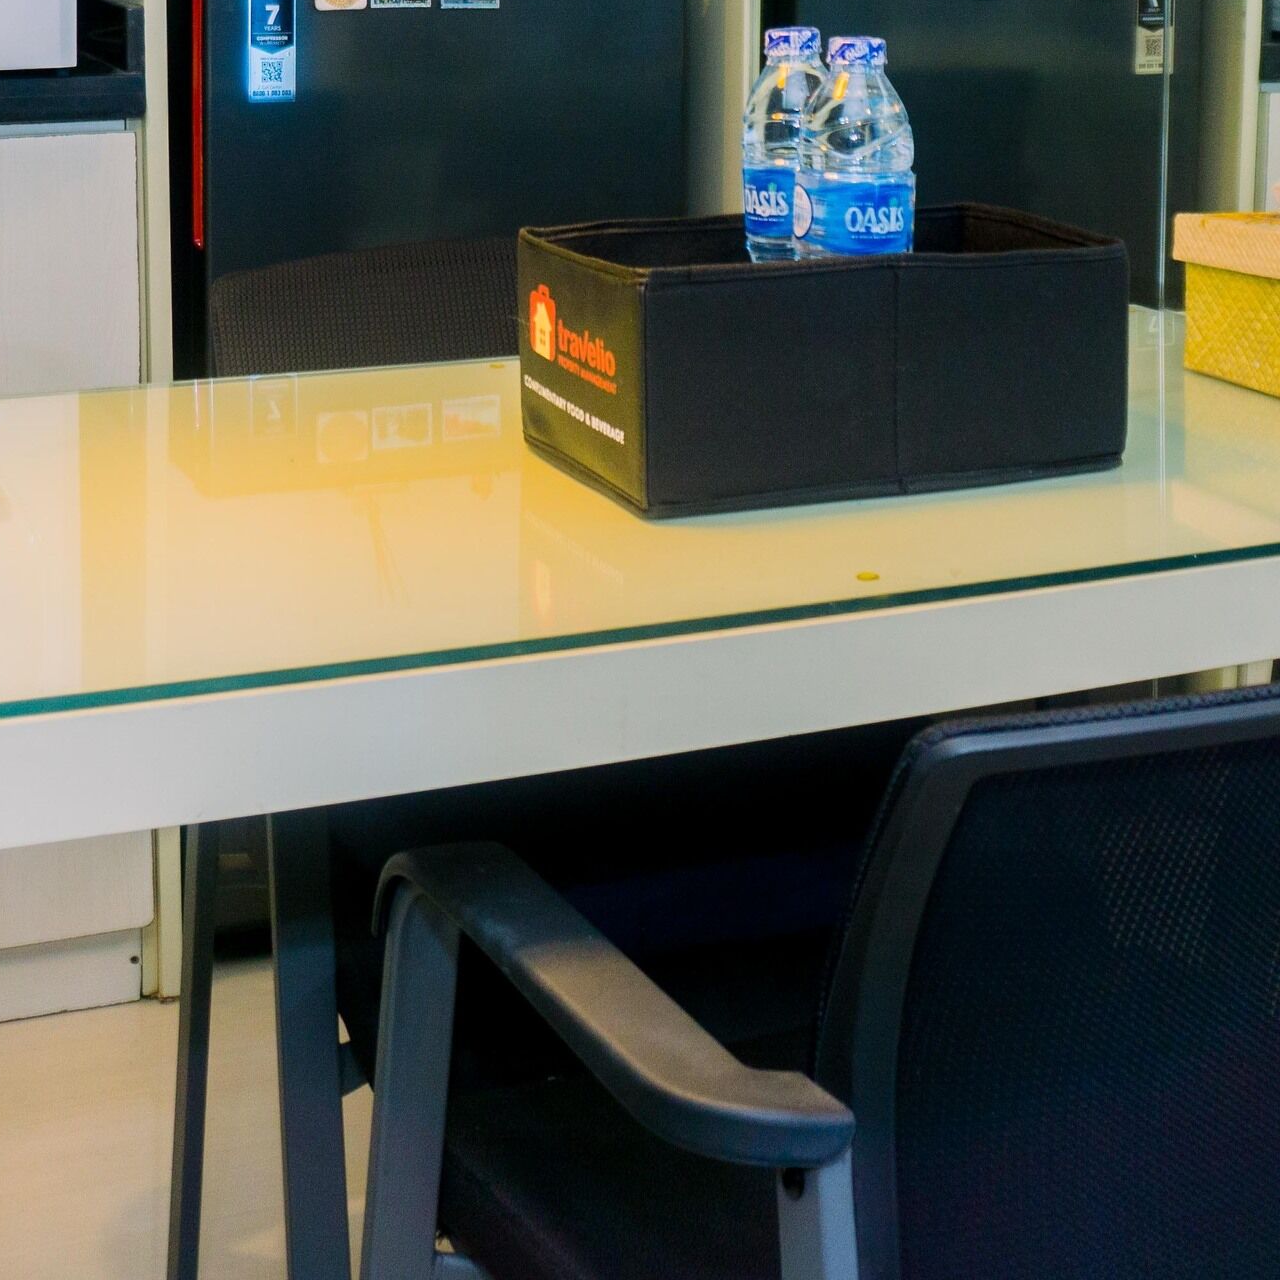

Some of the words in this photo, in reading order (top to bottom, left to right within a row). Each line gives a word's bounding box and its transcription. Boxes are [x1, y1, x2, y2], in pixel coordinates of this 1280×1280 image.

[265, 4, 280, 25] 7
[745, 189, 789, 218] OASIS
[845, 206, 904, 234] OASIS
[558, 319, 616, 377] travelio
